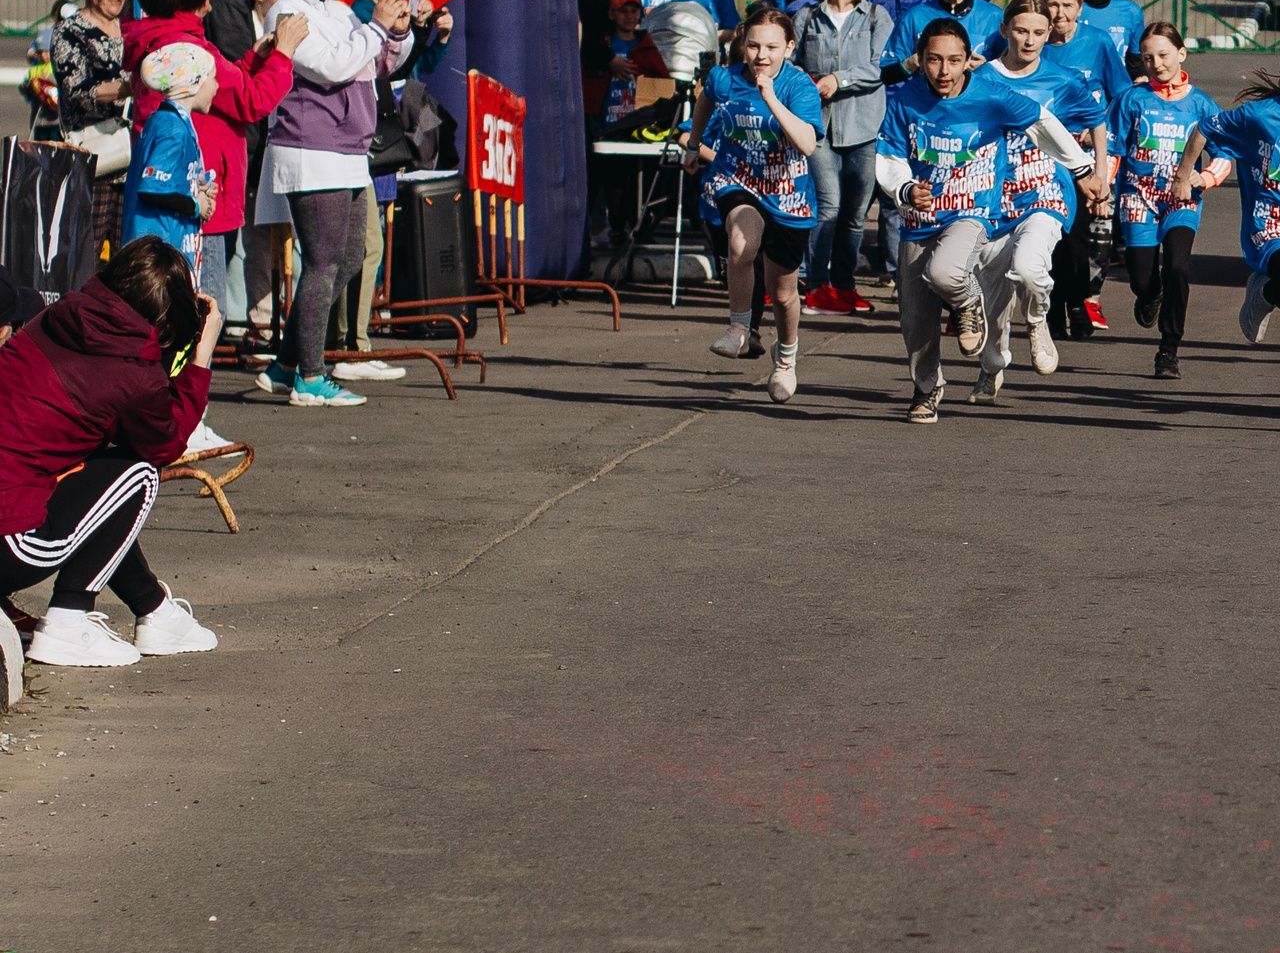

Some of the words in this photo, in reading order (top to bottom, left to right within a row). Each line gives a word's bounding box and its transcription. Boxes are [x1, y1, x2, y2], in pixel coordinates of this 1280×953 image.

[735, 114, 763, 129] 10017
[1152, 123, 1185, 139] 10034
[930, 136, 963, 152] 10013
[778, 192, 807, 210] 2024
